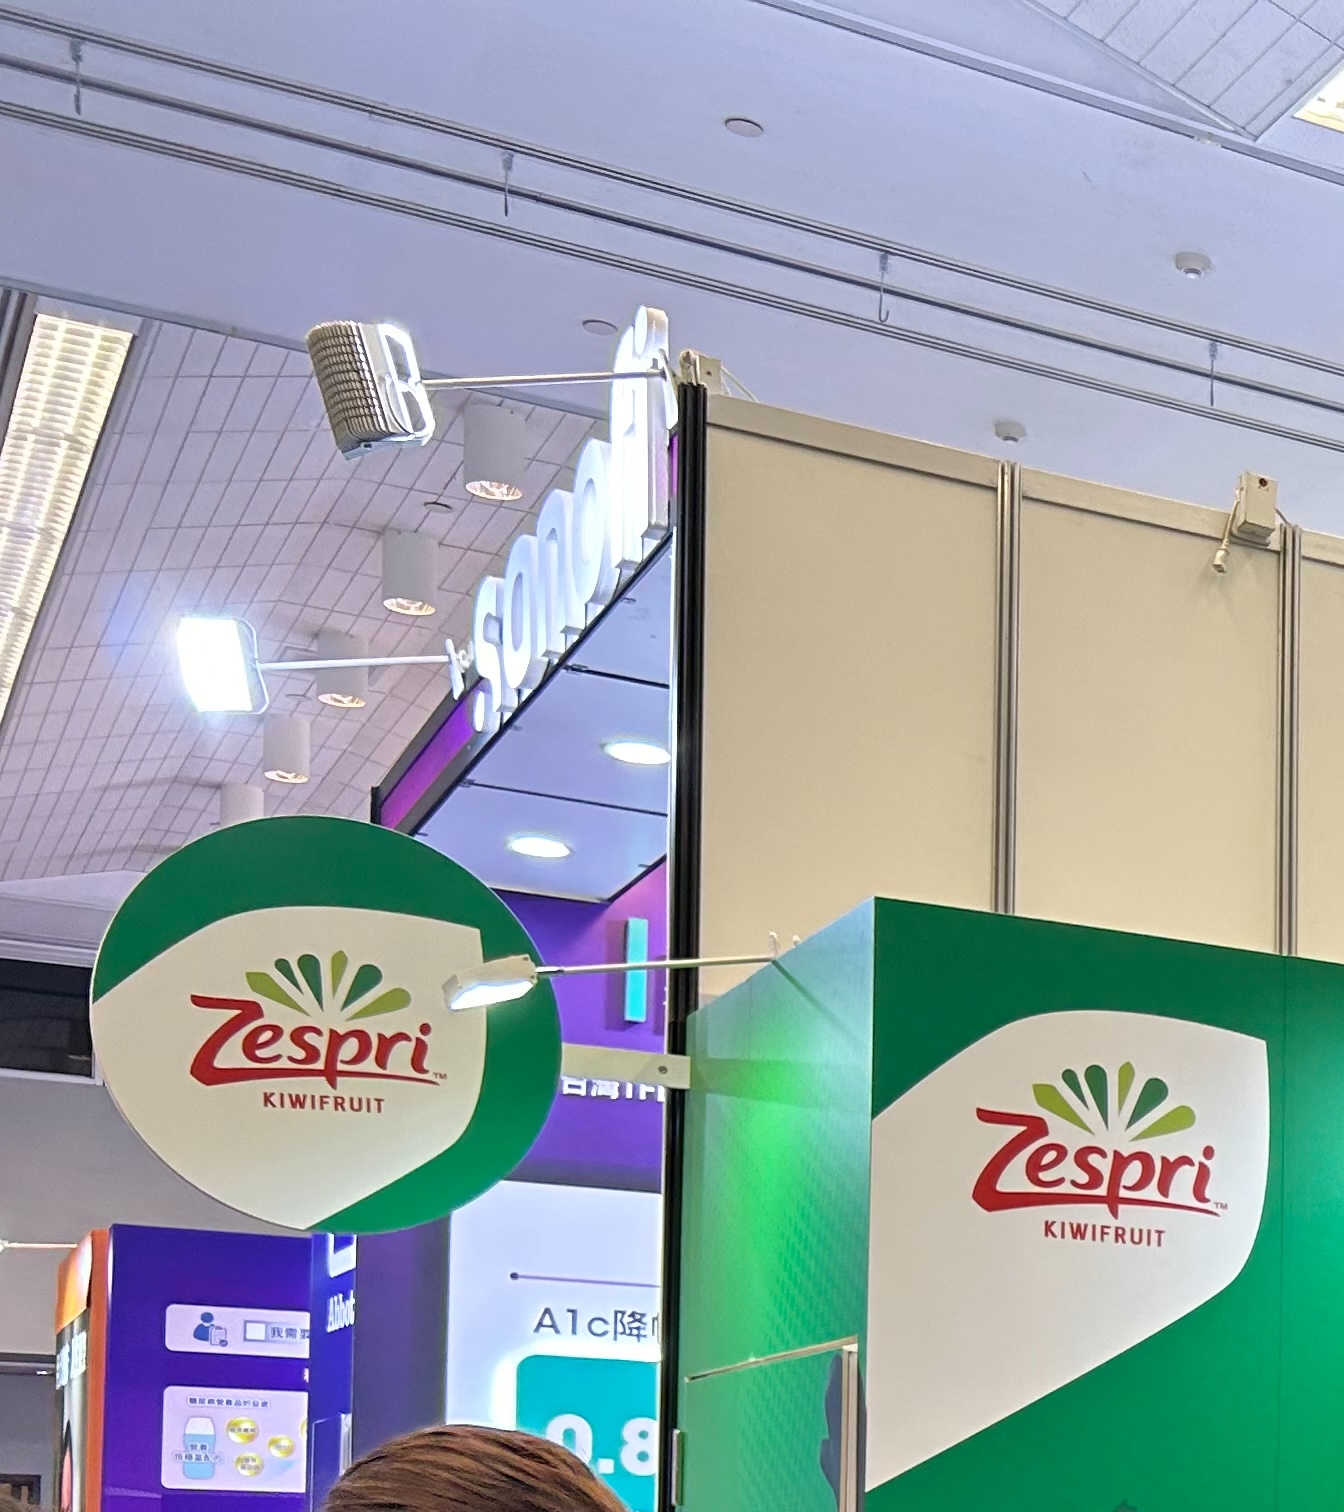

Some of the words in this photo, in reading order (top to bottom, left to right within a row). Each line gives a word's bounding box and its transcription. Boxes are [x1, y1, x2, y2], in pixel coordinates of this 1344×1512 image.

[190, 994, 440, 1090] Zespri
[263, 1091, 385, 1114] KIWIFRUIT
[972, 1107, 1220, 1220] Zespri
[1044, 1220, 1165, 1248] KIWIFRUIT
